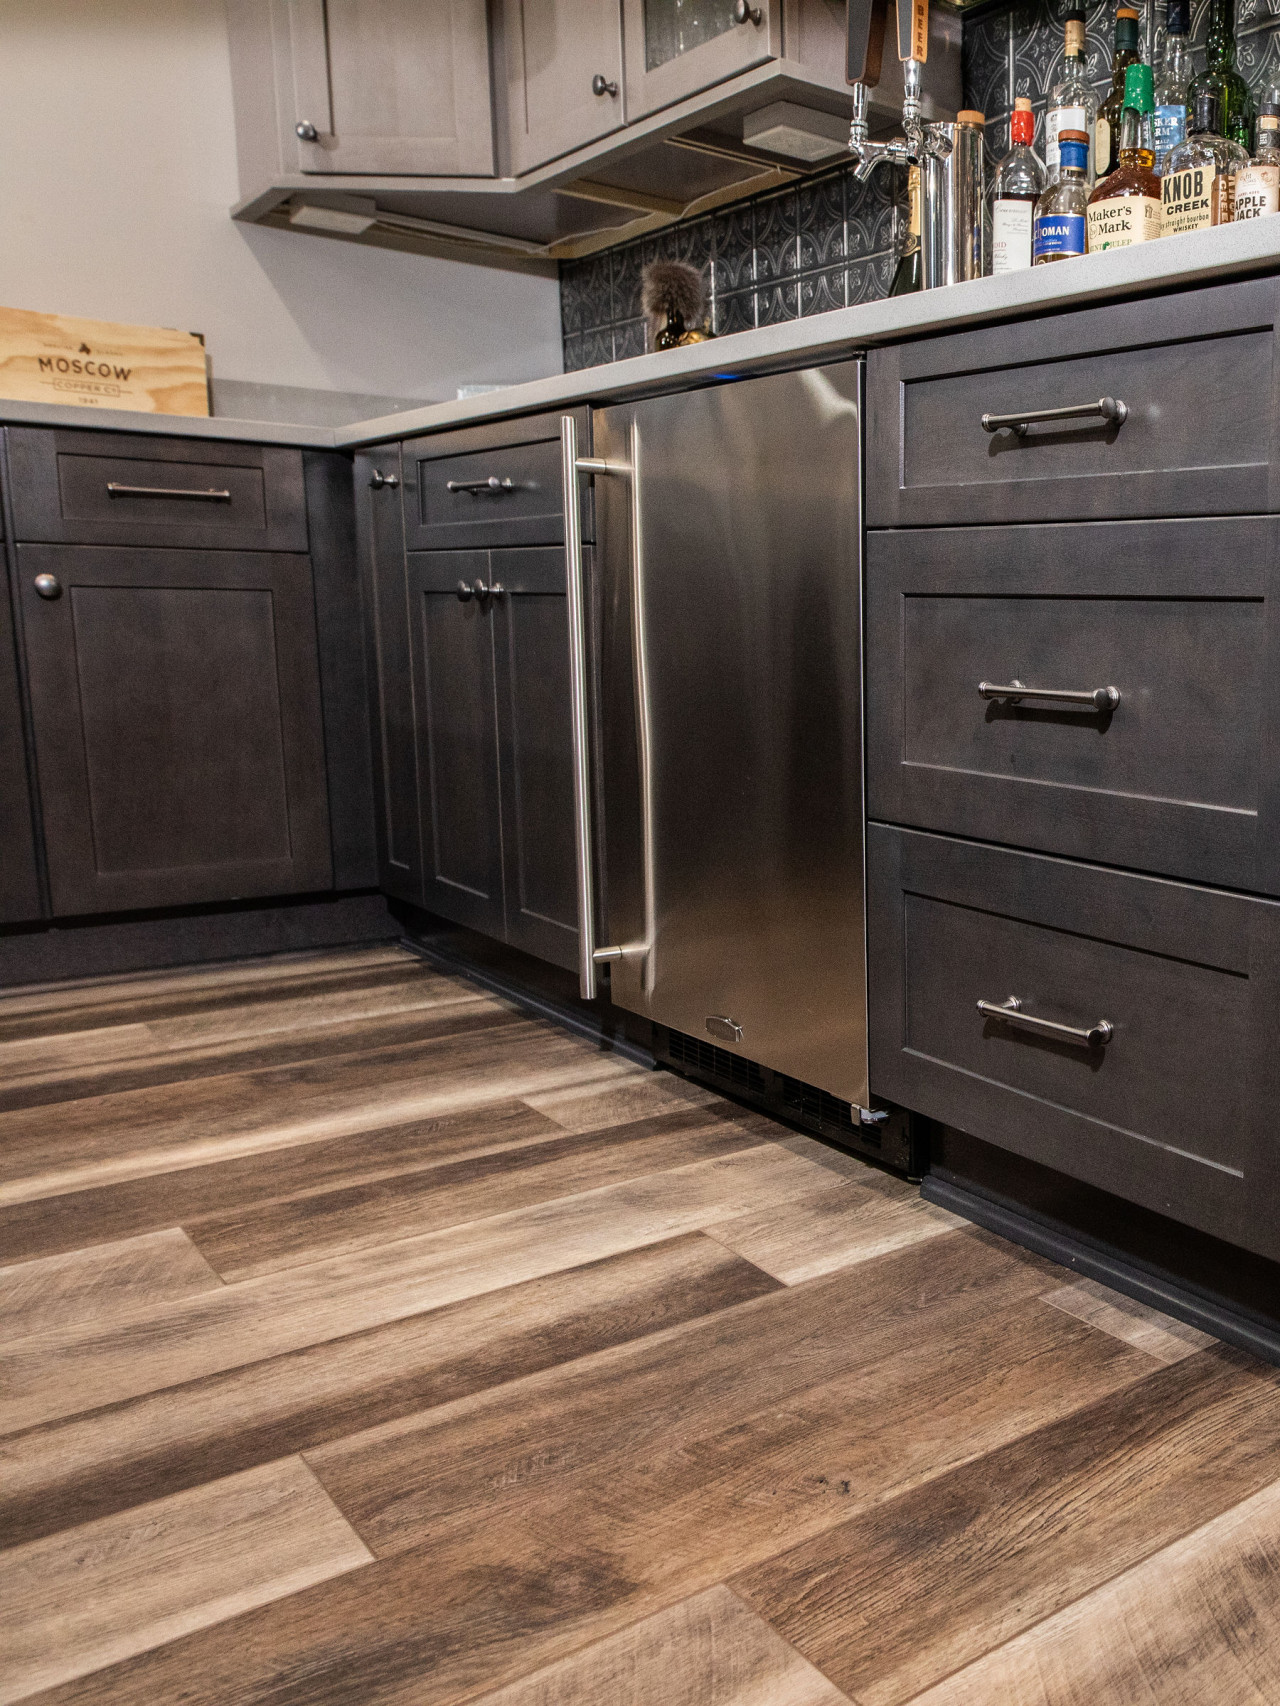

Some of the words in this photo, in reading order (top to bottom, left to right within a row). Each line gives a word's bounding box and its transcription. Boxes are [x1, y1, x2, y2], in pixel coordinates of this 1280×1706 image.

[916, 4, 924, 57] BEER
[1163, 170, 1204, 205] KNOB
[1166, 198, 1209, 215] CREEK
[1236, 196, 1266, 211] APPLE
[1088, 206, 1132, 224] Maker's
[1237, 207, 1261, 220] JACK
[1098, 220, 1131, 236] Mark
[1173, 222, 1198, 233] WHISKEY
[38, 357, 133, 381] MOSCOW
